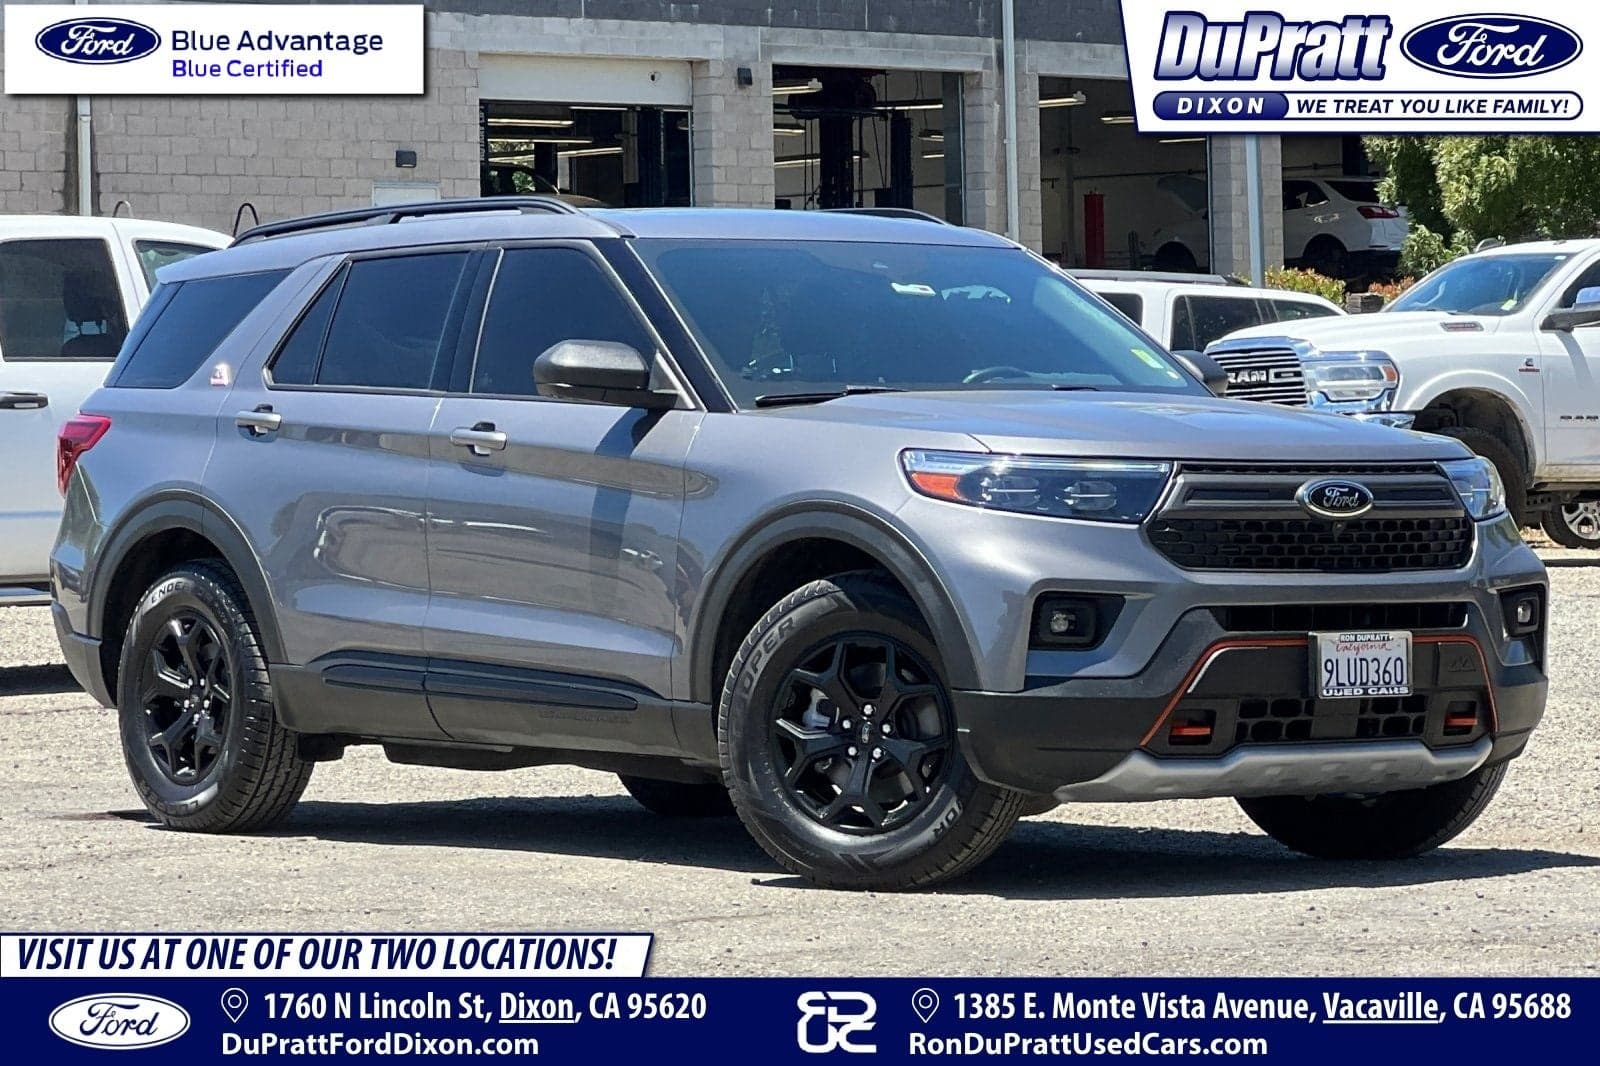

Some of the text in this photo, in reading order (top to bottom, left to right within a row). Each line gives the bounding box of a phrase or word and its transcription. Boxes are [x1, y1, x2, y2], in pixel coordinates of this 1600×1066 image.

[1322, 486, 1360, 507] Ford
[1340, 633, 1356, 642] RON
[1335, 642, 1392, 656] California
[1323, 656, 1405, 687] 9LUD360
